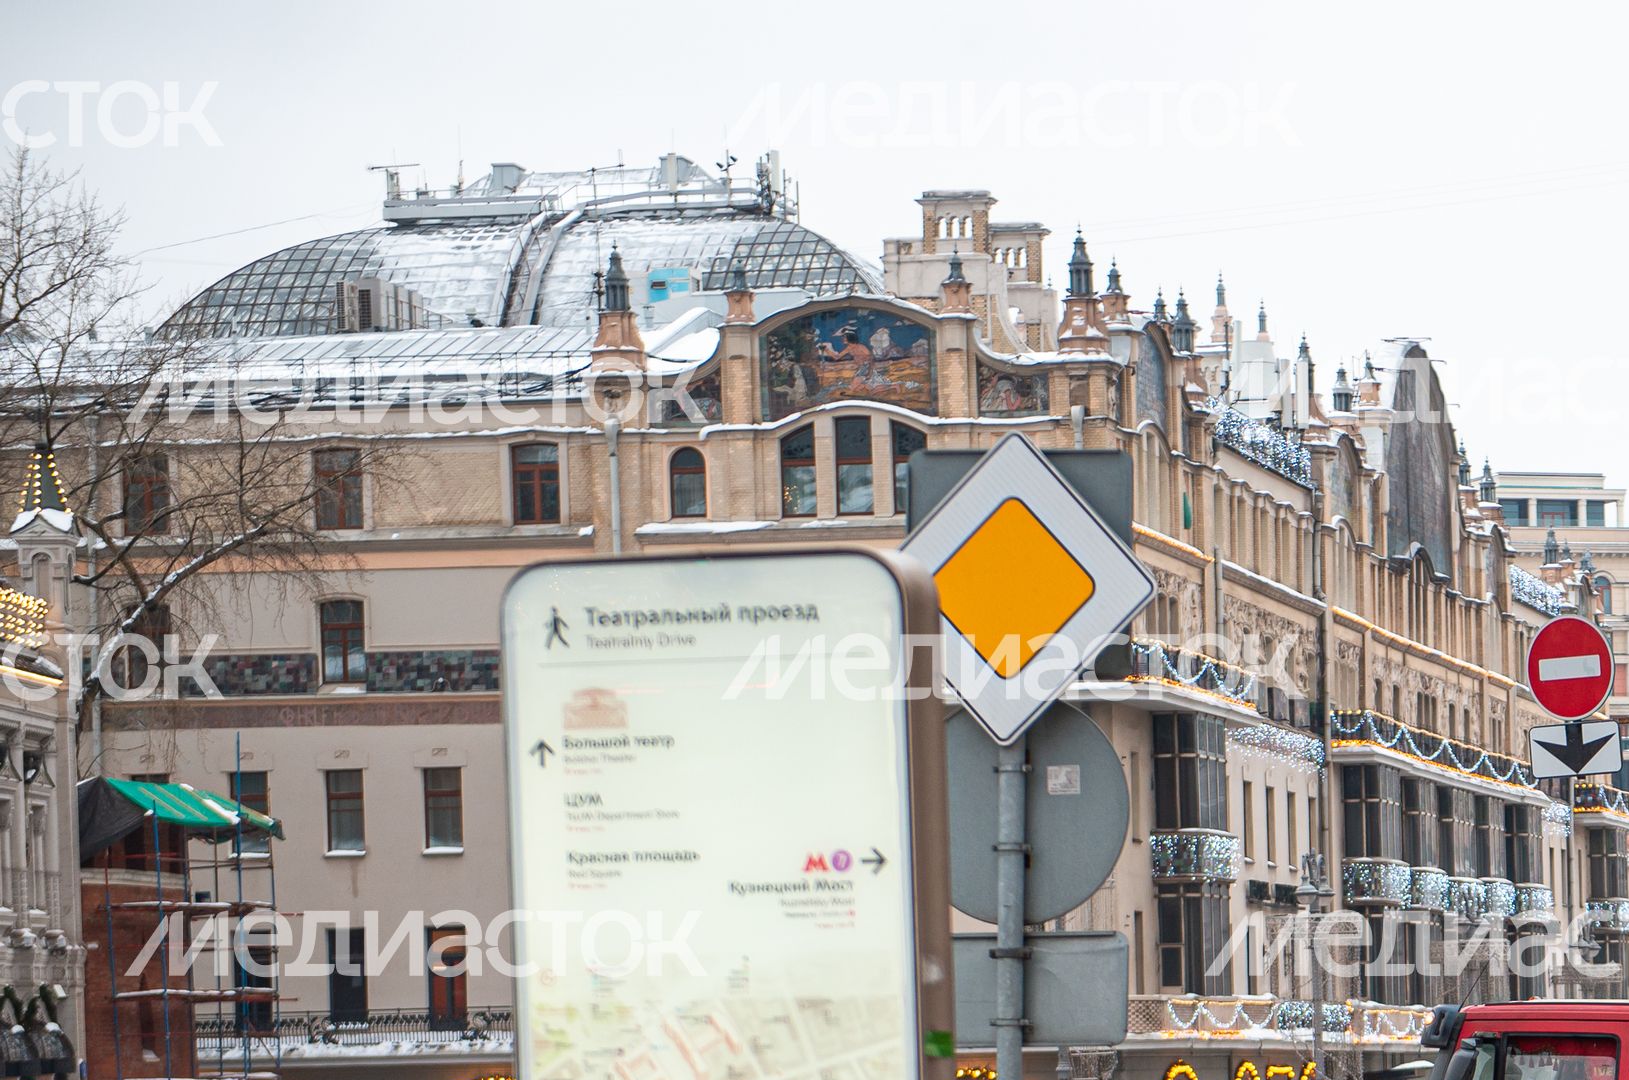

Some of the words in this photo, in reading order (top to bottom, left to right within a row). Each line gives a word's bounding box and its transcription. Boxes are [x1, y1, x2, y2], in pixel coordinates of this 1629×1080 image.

[585, 602, 731, 630] Театральный
[738, 603, 819, 625] проезд
[659, 632, 696, 647] Drive
[562, 734, 630, 749] Большой
[634, 735, 675, 749] театр
[564, 792, 603, 808] ЦУМ
[567, 850, 629, 866] Красная
[633, 849, 701, 863] площадь
[729, 880, 810, 896] Кузнецкий
[813, 878, 854, 893] Мост
